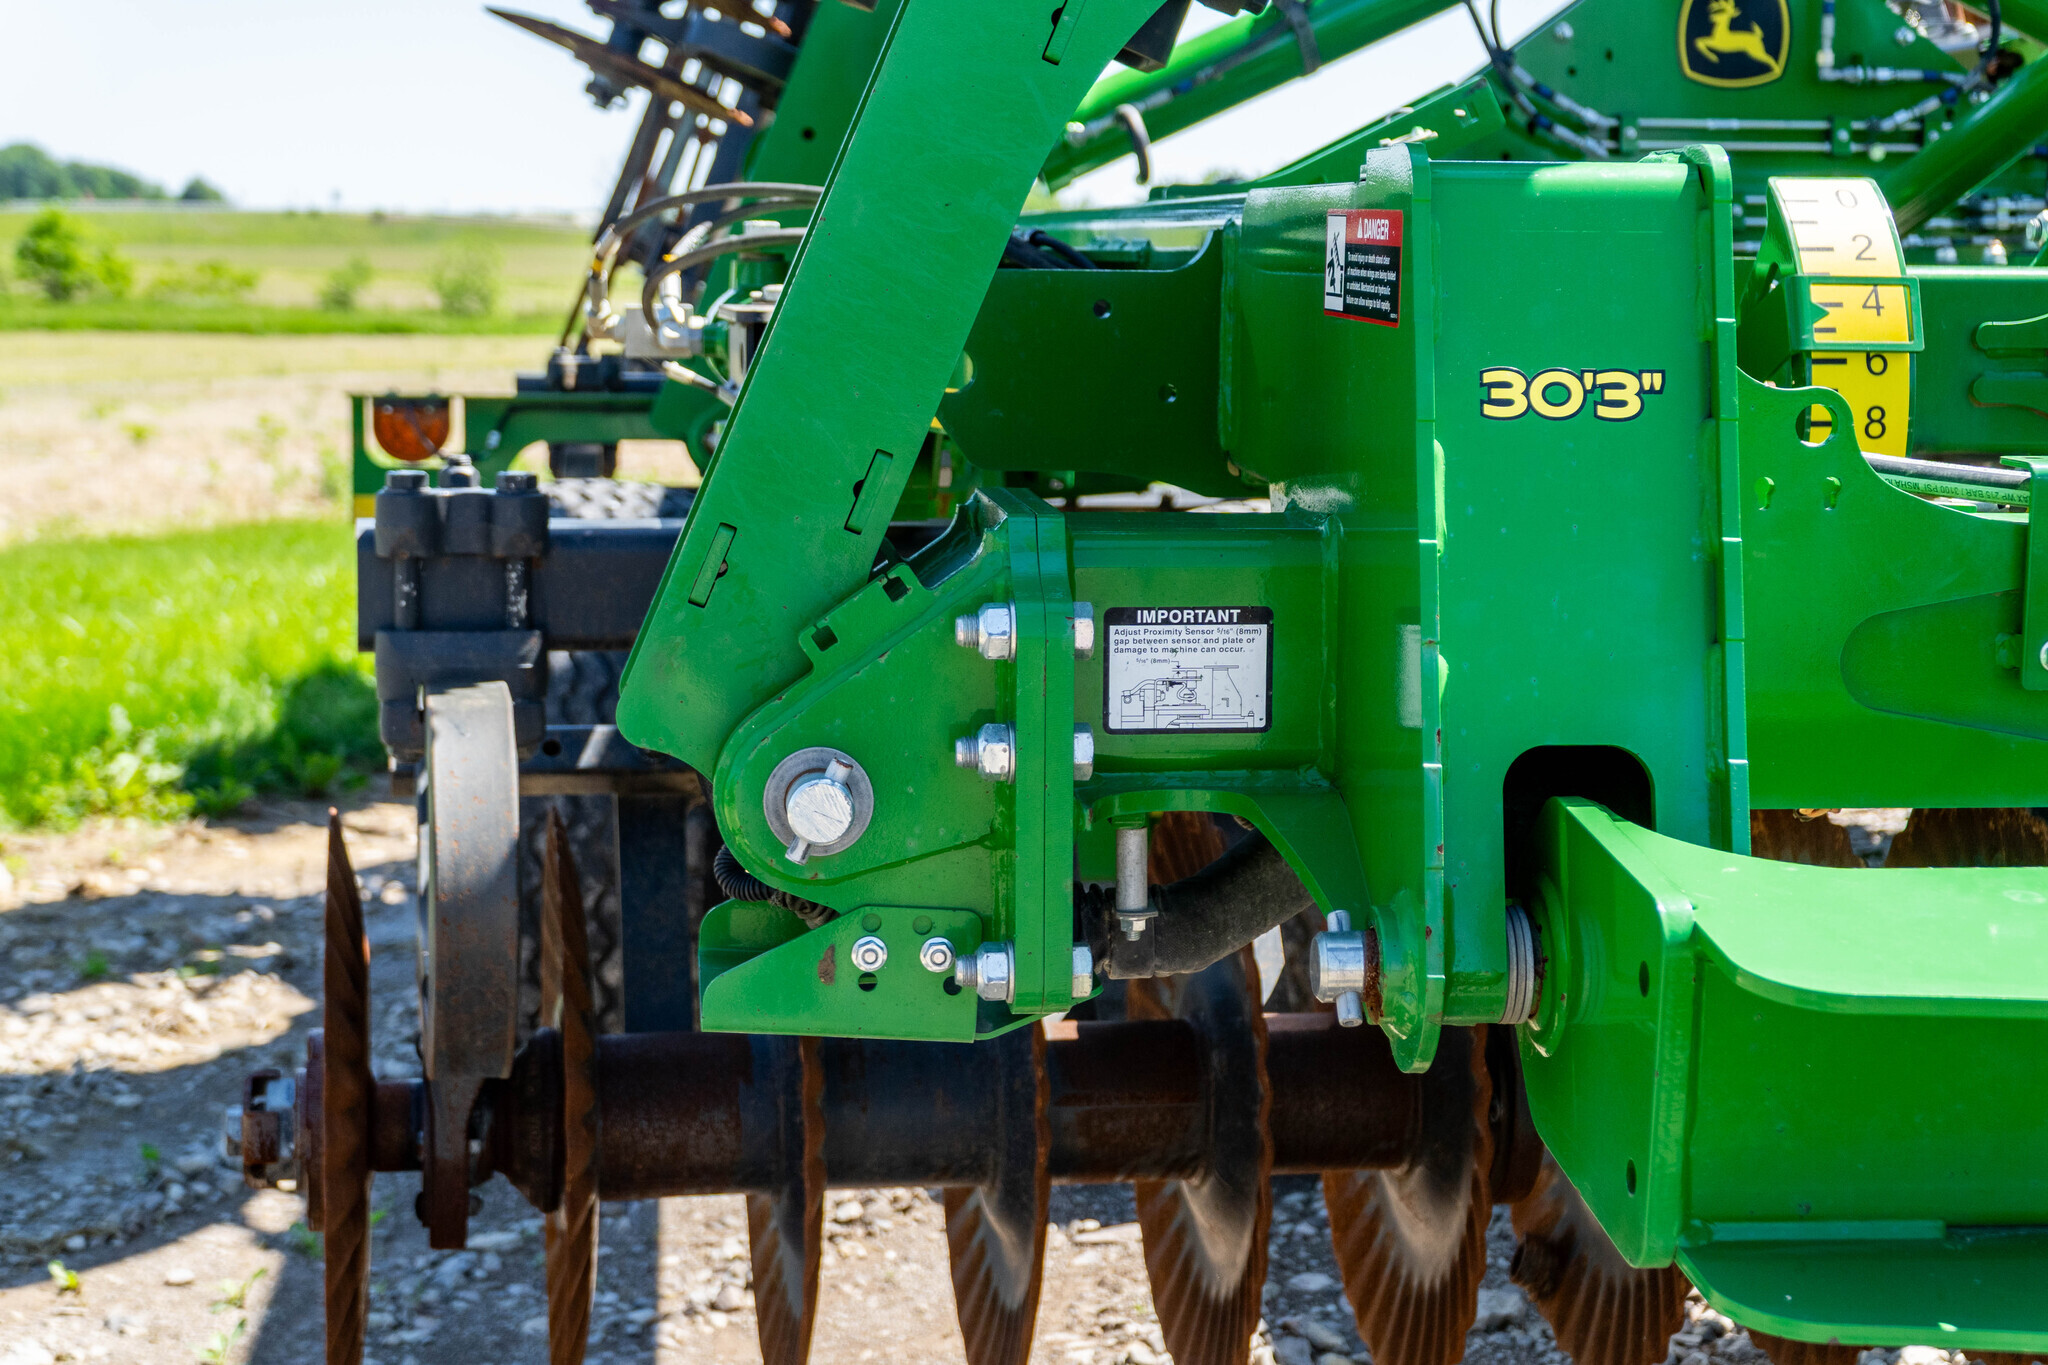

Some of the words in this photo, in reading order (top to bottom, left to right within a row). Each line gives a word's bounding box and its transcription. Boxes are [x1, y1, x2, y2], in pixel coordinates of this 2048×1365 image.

[1835, 189, 1858, 209] 0
[1364, 218, 1390, 240] DANGER
[1852, 234, 1877, 261] 2
[1350, 267, 1360, 276] machine
[1862, 285, 1884, 317] 4
[1865, 352, 1888, 376] 6
[1480, 366, 1666, 422] 30'3"
[1864, 405, 1887, 440] 8
[1895, 479, 1920, 491] MSHA
[1924, 483, 1939, 493] PSI
[1942, 485, 1960, 497] 3100
[1966, 488, 1984, 500] BAR
[1137, 609, 1241, 624] IMPORTANT
[1114, 628, 1142, 637] Adjust
[1143, 627, 1183, 637] Proximity
[1185, 627, 1215, 636] Sensor
[1235, 626, 1263, 636] (8mm)
[1113, 638, 1131, 647] gap
[1132, 636, 1169, 645] between
[1171, 637, 1201, 645] sensor
[1203, 636, 1220, 645] and
[1222, 635, 1244, 645] plate
[1246, 637, 1256, 645] or
[1113, 646, 1148, 656] damage
[1150, 647, 1160, 655] to
[1200, 646, 1217, 654] can
[1219, 645, 1246, 654] occur.
[1150, 656, 1171, 665] (8mm)
